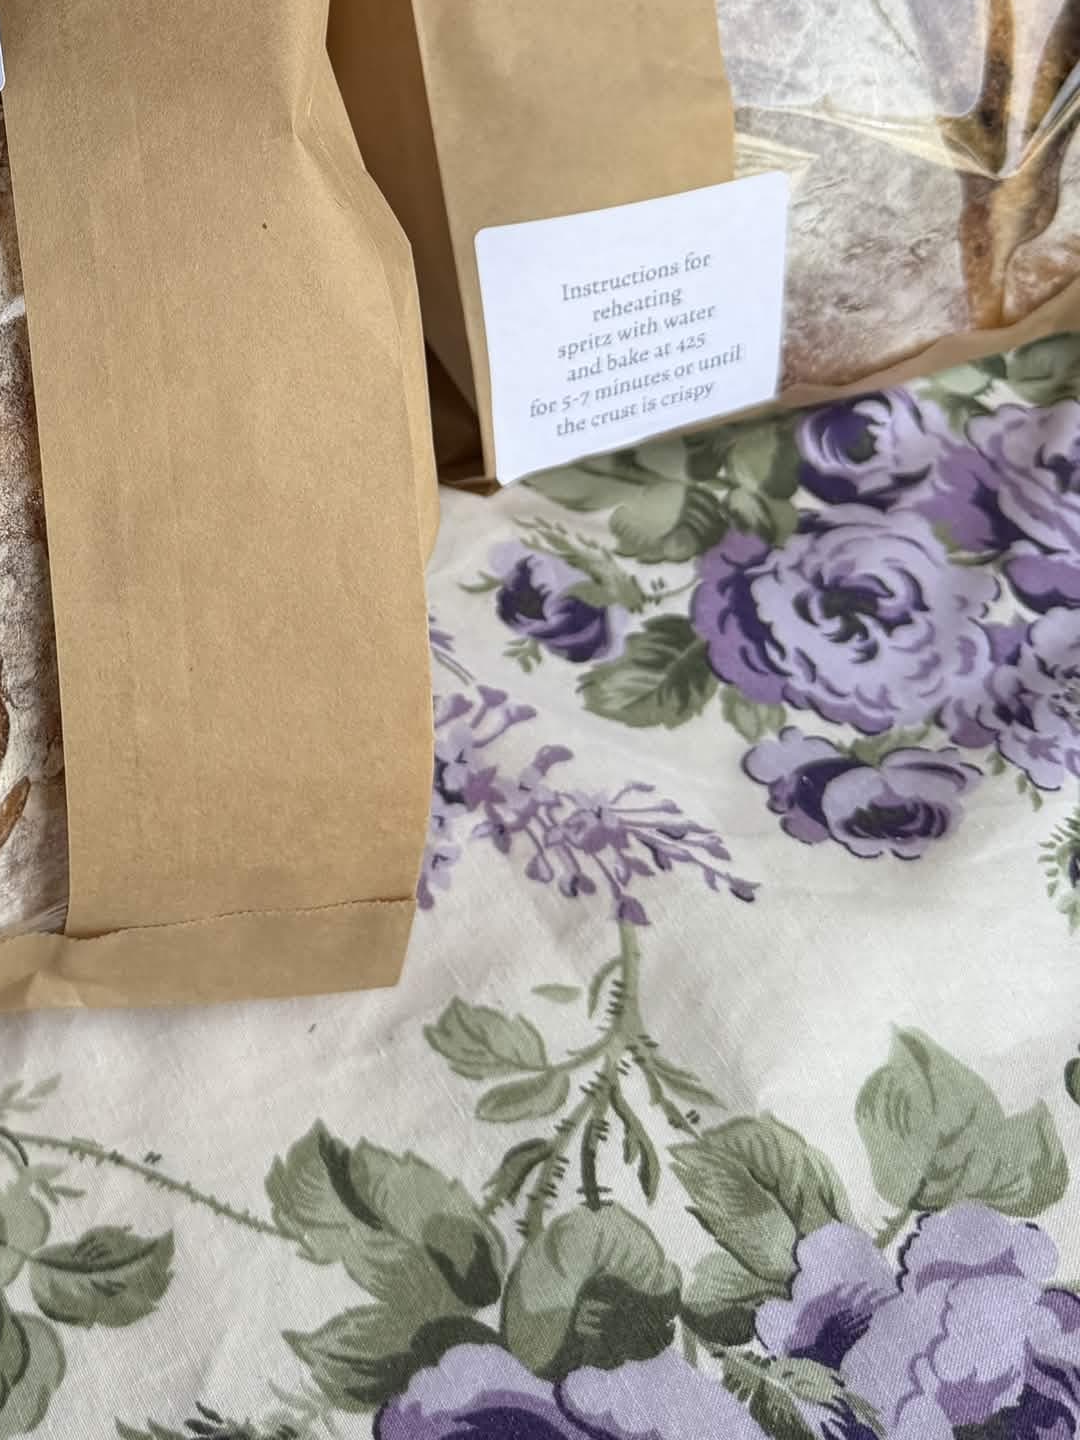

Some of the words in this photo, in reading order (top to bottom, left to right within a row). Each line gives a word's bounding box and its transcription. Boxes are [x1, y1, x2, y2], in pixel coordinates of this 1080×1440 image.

[561, 261, 681, 302] Instructions
[684, 250, 712, 273] for
[592, 286, 683, 323] reheating
[557, 331, 613, 361] spritz
[617, 316, 659, 343] with
[663, 304, 717, 330] water
[566, 356, 603, 382] and
[606, 346, 650, 373] bake
[653, 342, 672, 359] at
[675, 332, 707, 354] 425
[529, 396, 557, 419] for
[561, 389, 591, 412] 5-7
[594, 367, 671, 402] minutes
[674, 360, 695, 379] or
[698, 343, 743, 373] until
[555, 415, 587, 438] the
[590, 400, 639, 428] crust
[641, 395, 658, 415] is
[660, 380, 716, 408] crispy
